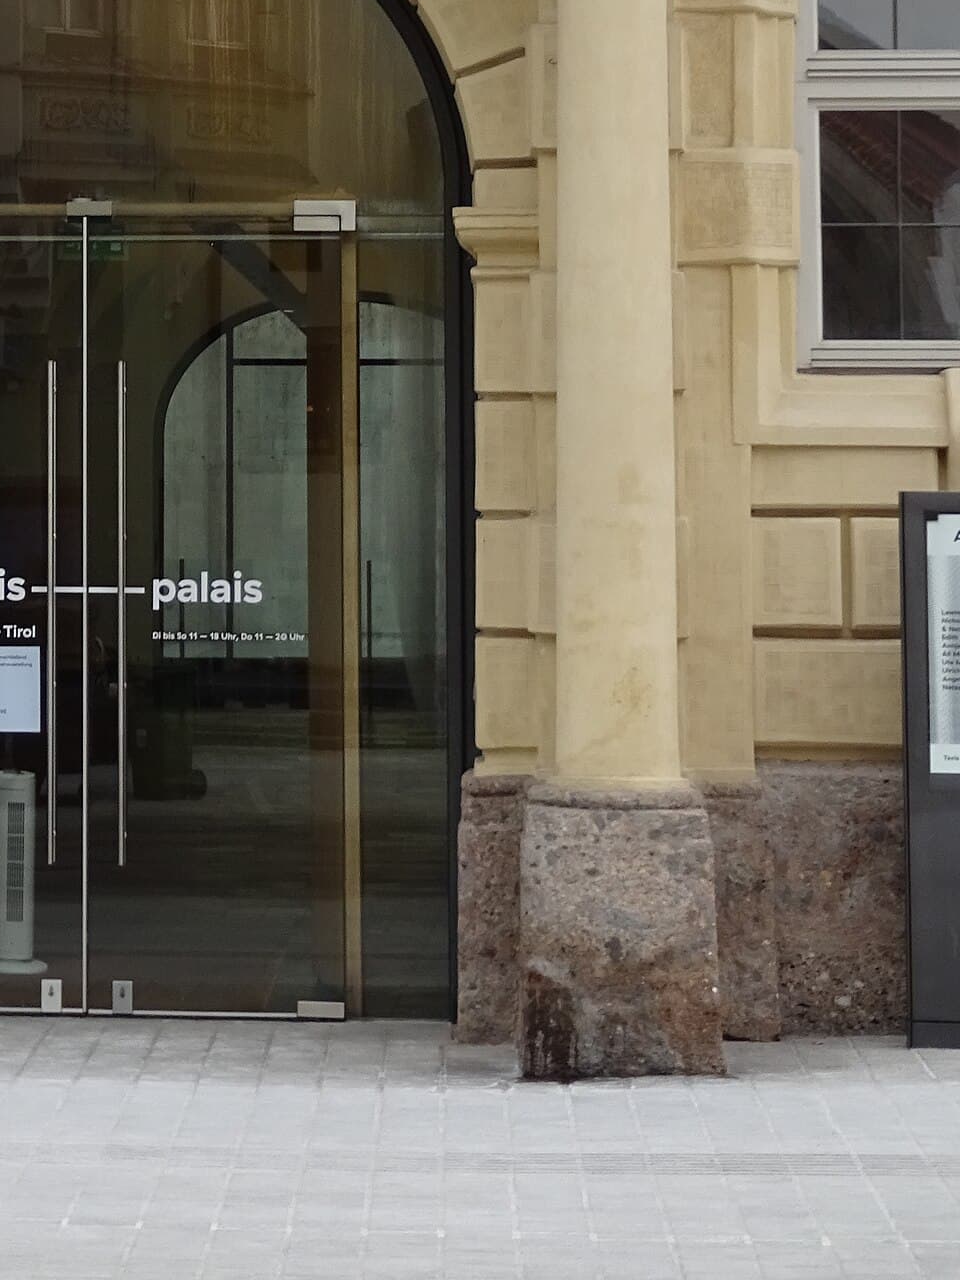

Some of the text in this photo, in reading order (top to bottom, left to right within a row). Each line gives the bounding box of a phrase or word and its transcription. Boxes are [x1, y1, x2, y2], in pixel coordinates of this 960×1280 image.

[152, 570, 263, 611] palais
[3, 625, 36, 638] Tirol
[152, 631, 161, 640] Di
[163, 631, 175, 640] bis
[177, 632, 186, 640] So
[189, 632, 198, 640] 11
[221, 632, 239, 642] Uhr,
[241, 632, 253, 641] Do
[254, 632, 264, 641] 11
[275, 632, 287, 641] 20
[289, 633, 305, 641] Uhr
